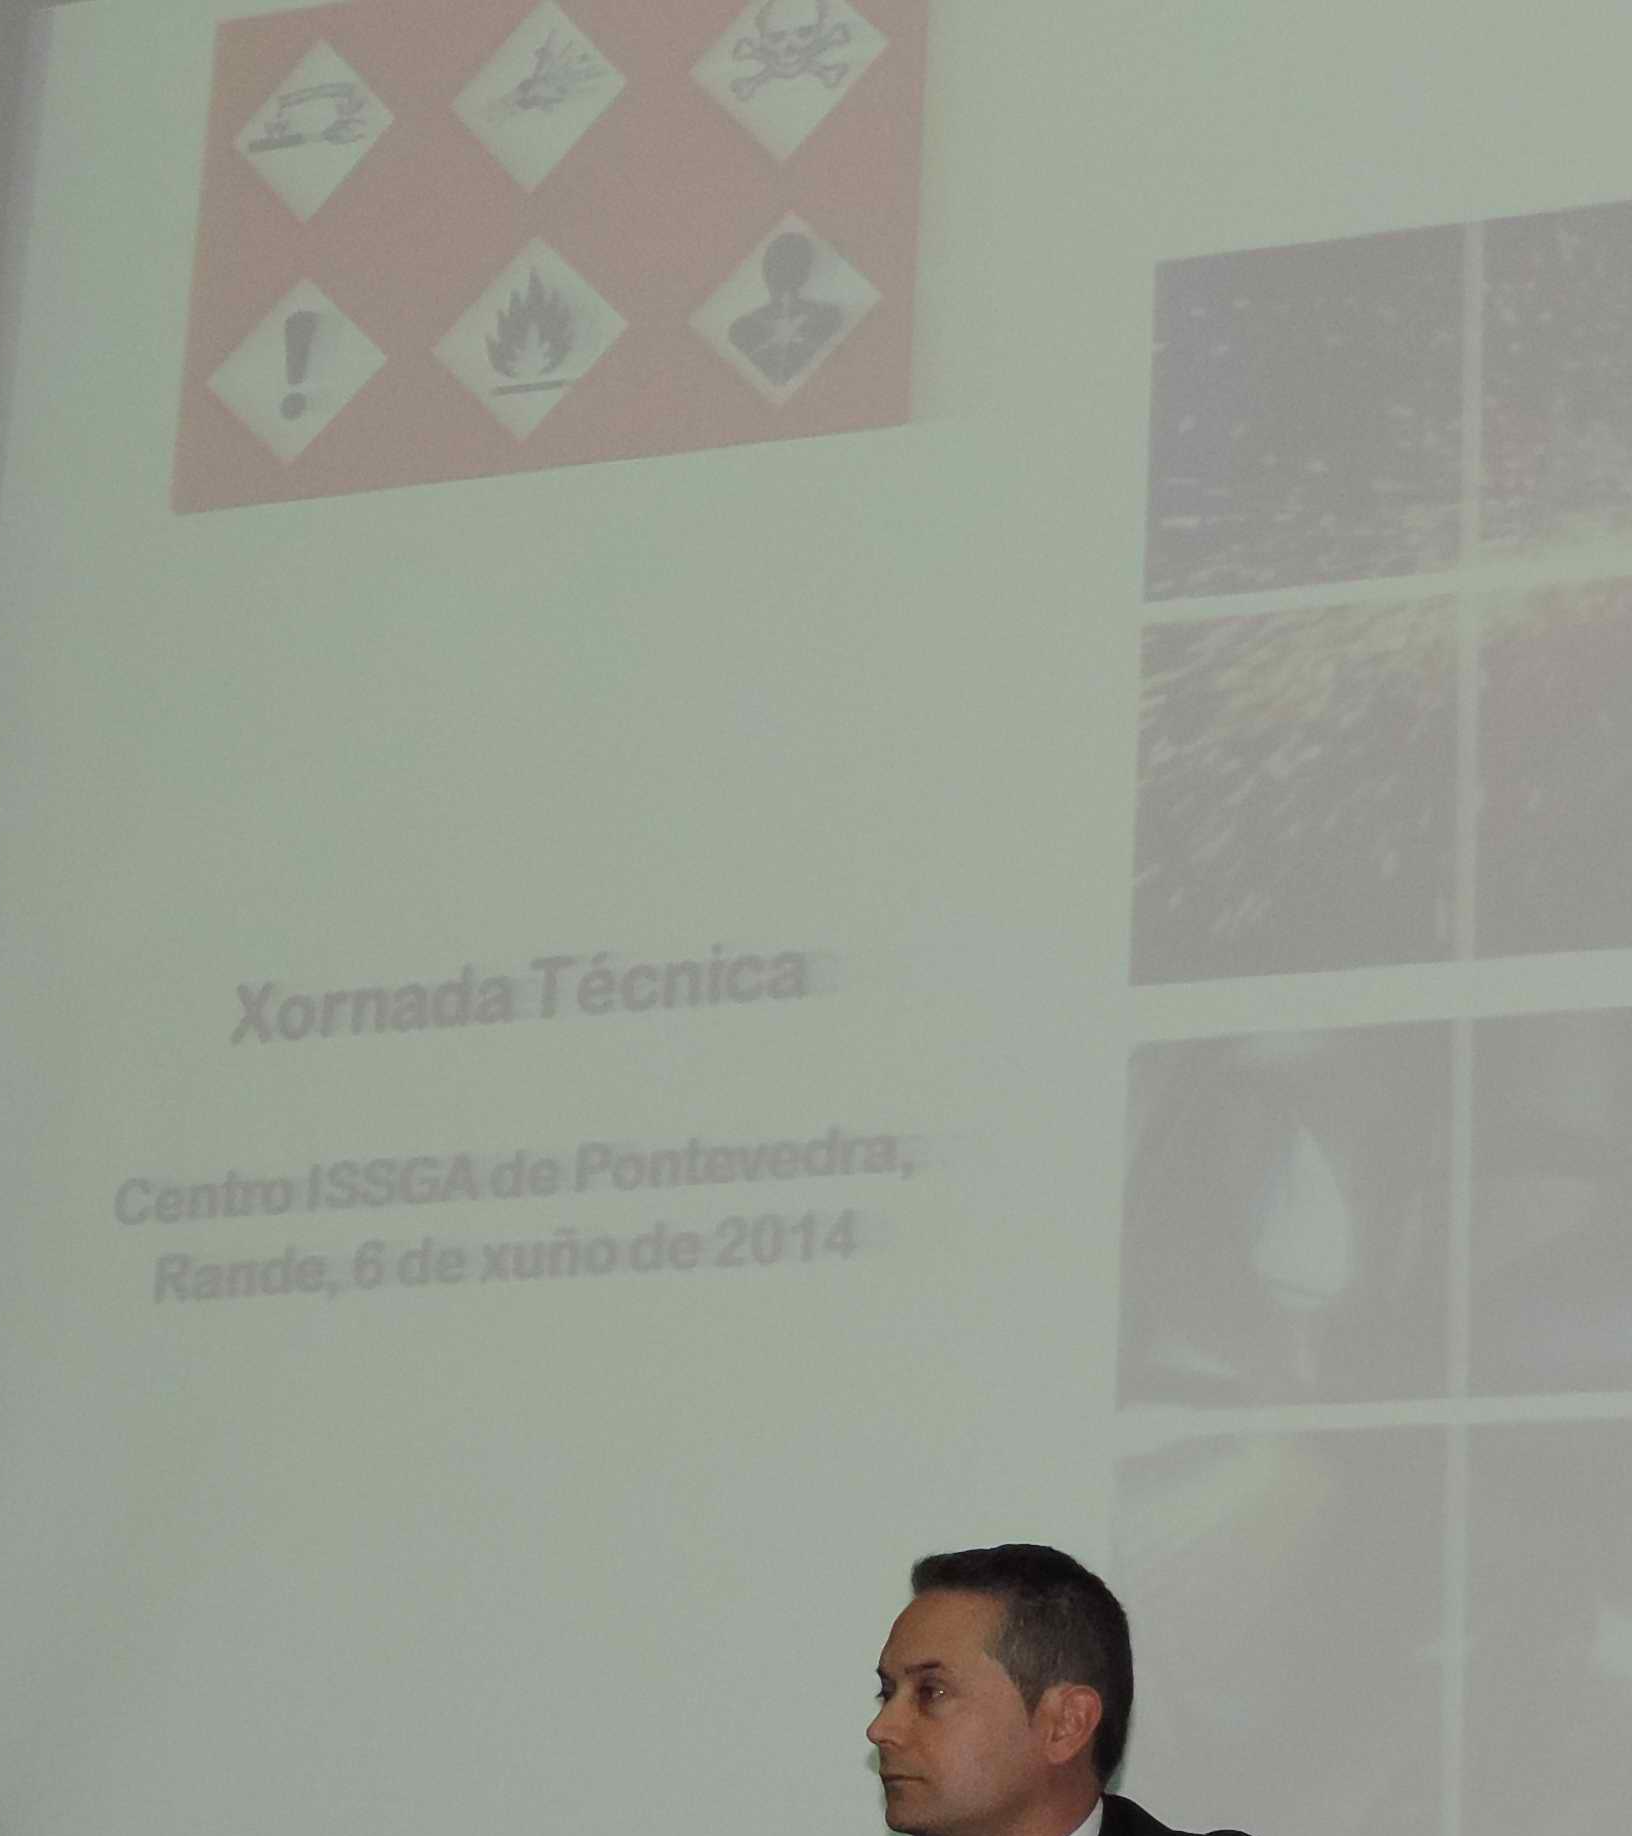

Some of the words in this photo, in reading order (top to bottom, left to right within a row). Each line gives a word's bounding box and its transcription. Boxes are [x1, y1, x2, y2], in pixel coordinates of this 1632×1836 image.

[230, 964, 515, 1045] Xornada
[530, 944, 811, 1020] Técnica
[114, 1170, 294, 1226] Centro
[306, 1154, 480, 1212] ISSGA
[489, 1150, 560, 1200] de
[575, 1125, 916, 1193] Pontevedra,
[153, 1246, 339, 1304] Rande,
[352, 1239, 385, 1290] 6
[396, 1236, 466, 1287] de
[479, 1226, 620, 1284] xuño
[629, 1220, 701, 1273] de
[714, 1208, 861, 1269] 2014
